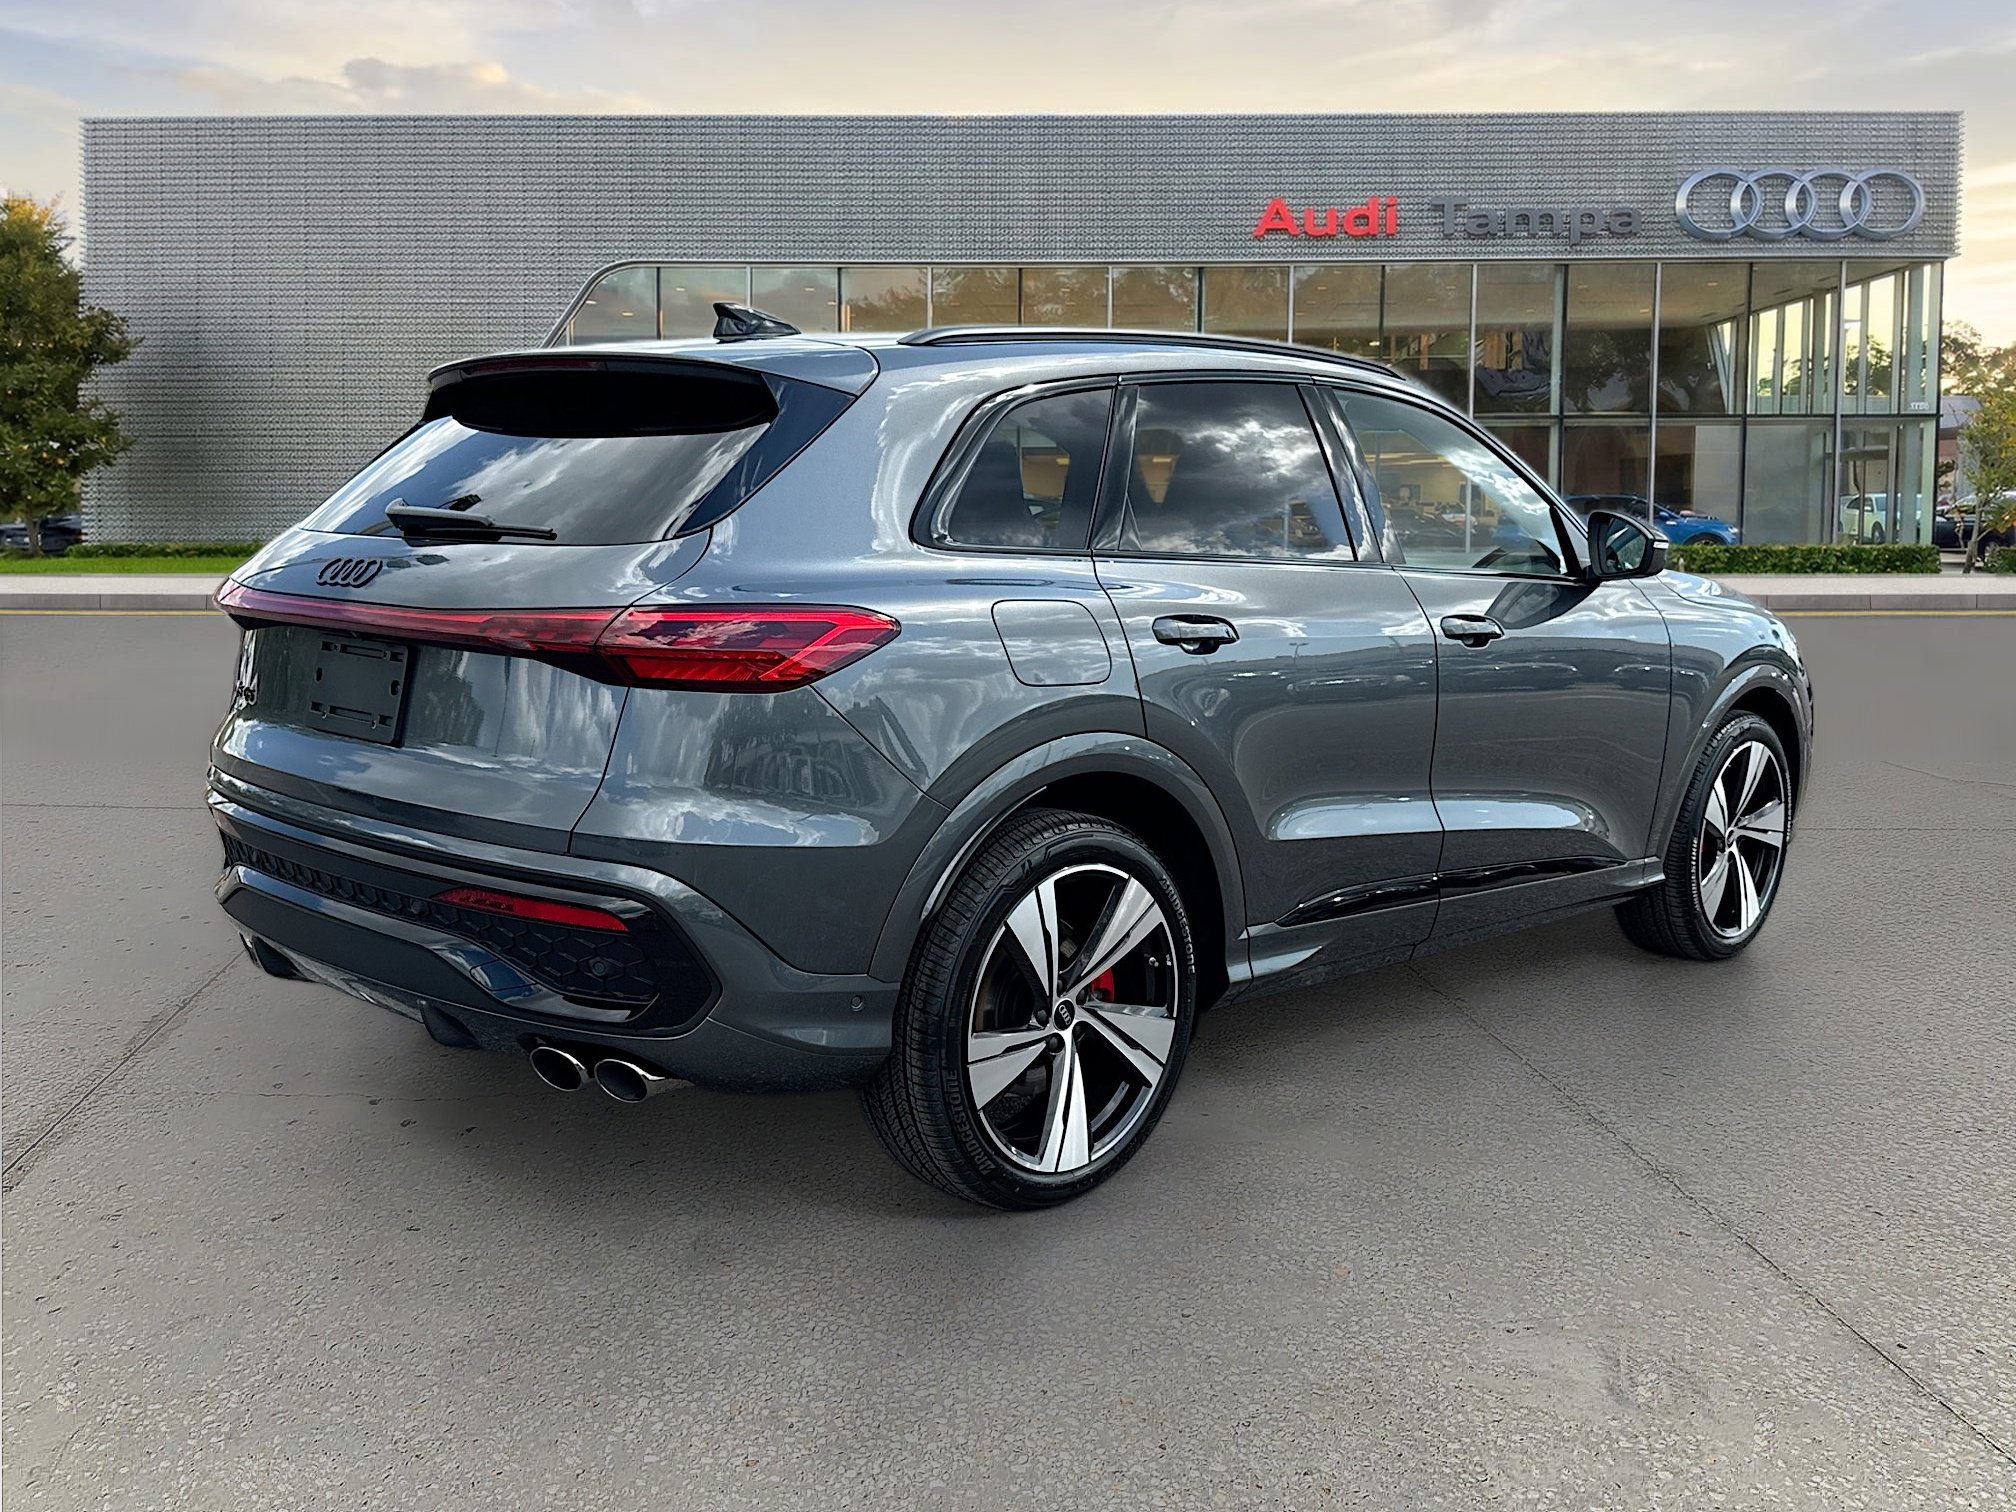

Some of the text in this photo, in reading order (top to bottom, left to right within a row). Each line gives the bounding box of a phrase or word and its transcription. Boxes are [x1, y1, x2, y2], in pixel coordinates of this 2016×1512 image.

[1252, 195, 1643, 246] Audi Tampa
[1158, 874, 1196, 974] BRIDGESTONE
